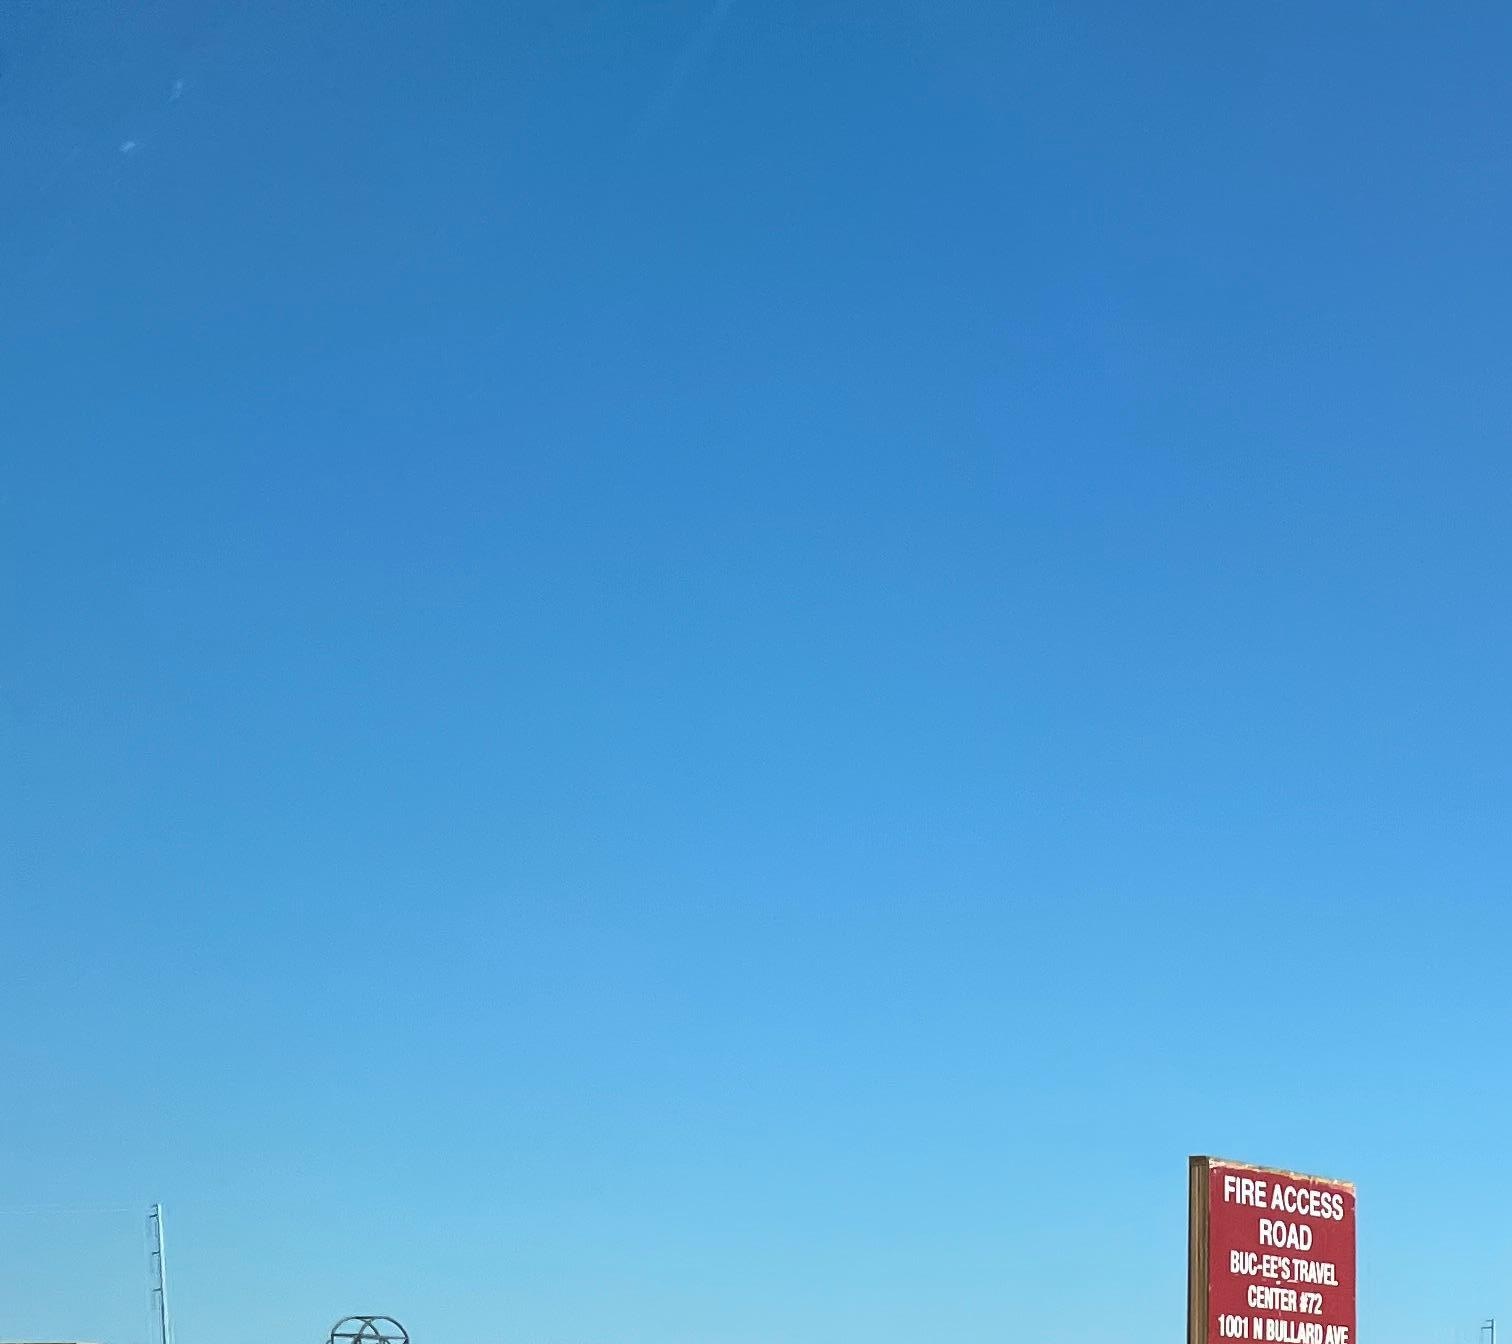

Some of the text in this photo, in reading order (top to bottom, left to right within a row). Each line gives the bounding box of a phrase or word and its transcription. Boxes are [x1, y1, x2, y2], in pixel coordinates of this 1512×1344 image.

[1224, 1175, 1344, 1221] FIRE ACCESS
[1259, 1218, 1313, 1251] ROAD
[1230, 1249, 1339, 1286] BUC-EE'S TRAVEL
[1247, 1284, 1323, 1315] CENTER #72
[1218, 1314, 1249, 1339] 1001
[1252, 1317, 1263, 1340] N
